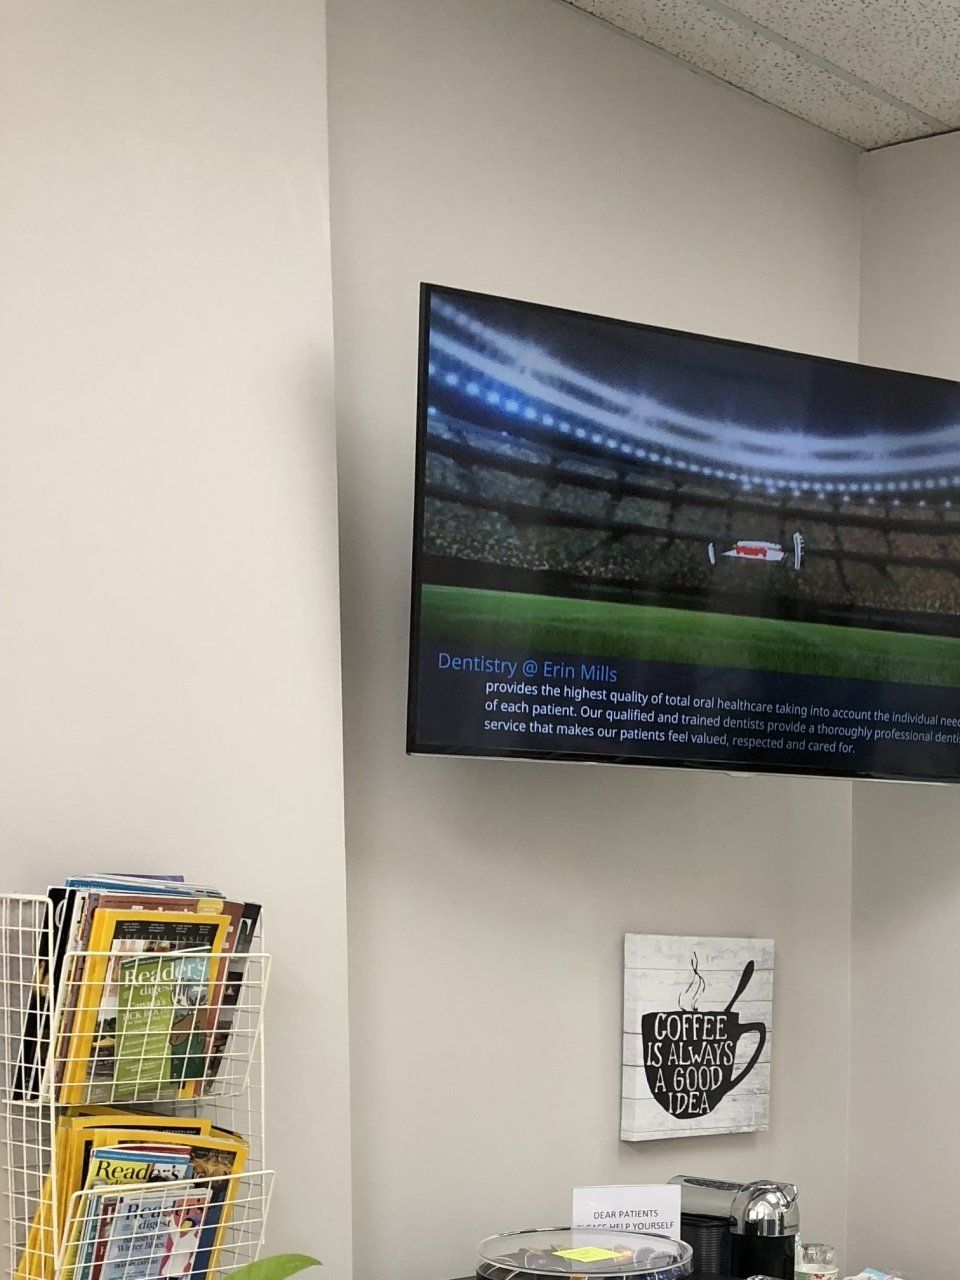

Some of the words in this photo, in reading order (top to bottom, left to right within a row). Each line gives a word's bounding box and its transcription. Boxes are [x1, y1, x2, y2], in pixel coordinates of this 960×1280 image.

[438, 652, 517, 677] Dentistry
[522, 659, 538, 677] @
[543, 661, 575, 678] Erin
[580, 664, 618, 683] Mills
[485, 680, 538, 695] provides
[541, 684, 561, 697] the
[563, 685, 607, 701] highest
[610, 689, 648, 705] quality
[651, 692, 663, 704] of
[665, 693, 690, 707] total
[693, 695, 714, 708] oral
[717, 697, 773, 713] healthcare
[775, 701, 807, 717] taking
[810, 704, 830, 718] into
[832, 707, 871, 721] account
[873, 710, 890, 722] the
[892, 711, 938, 725] individual
[485, 699, 498, 711] of
[501, 701, 529, 713] each
[532, 703, 577, 718] patient.
[580, 705, 602, 718] Our
[606, 706, 654, 725] qualified
[657, 710, 678, 724] and
[681, 711, 720, 727] trained
[723, 715, 764, 731] dentists
[767, 720, 806, 735] provide
[808, 725, 815, 734] a
[817, 723, 872, 741] thoroughly
[874, 726, 933, 742] professional
[484, 719, 526, 732] service
[529, 720, 554, 733] that
[556, 723, 594, 737] makes
[597, 727, 617, 738] our
[620, 726, 665, 743] patients
[668, 729, 689, 743] feel
[691, 731, 729, 747] valued,
[732, 735, 784, 751] respected
[786, 738, 805, 751] and
[808, 740, 836, 752] cared
[838, 742, 856, 754] for.
[654, 1013, 728, 1041] COFFEE
[646, 1042, 662, 1067] IS
[668, 1041, 734, 1066] ALWAYS
[654, 1068, 666, 1093] A
[673, 1066, 723, 1092] GOOD
[668, 1092, 710, 1114] IDEA
[96, 1160, 180, 1180] Reade's
[139, 1219, 171, 1231] digest
[593, 1210, 617, 1220] DEAR
[618, 1209, 659, 1219] PATIENTS
[632, 1221, 675, 1231] YOURSELF
